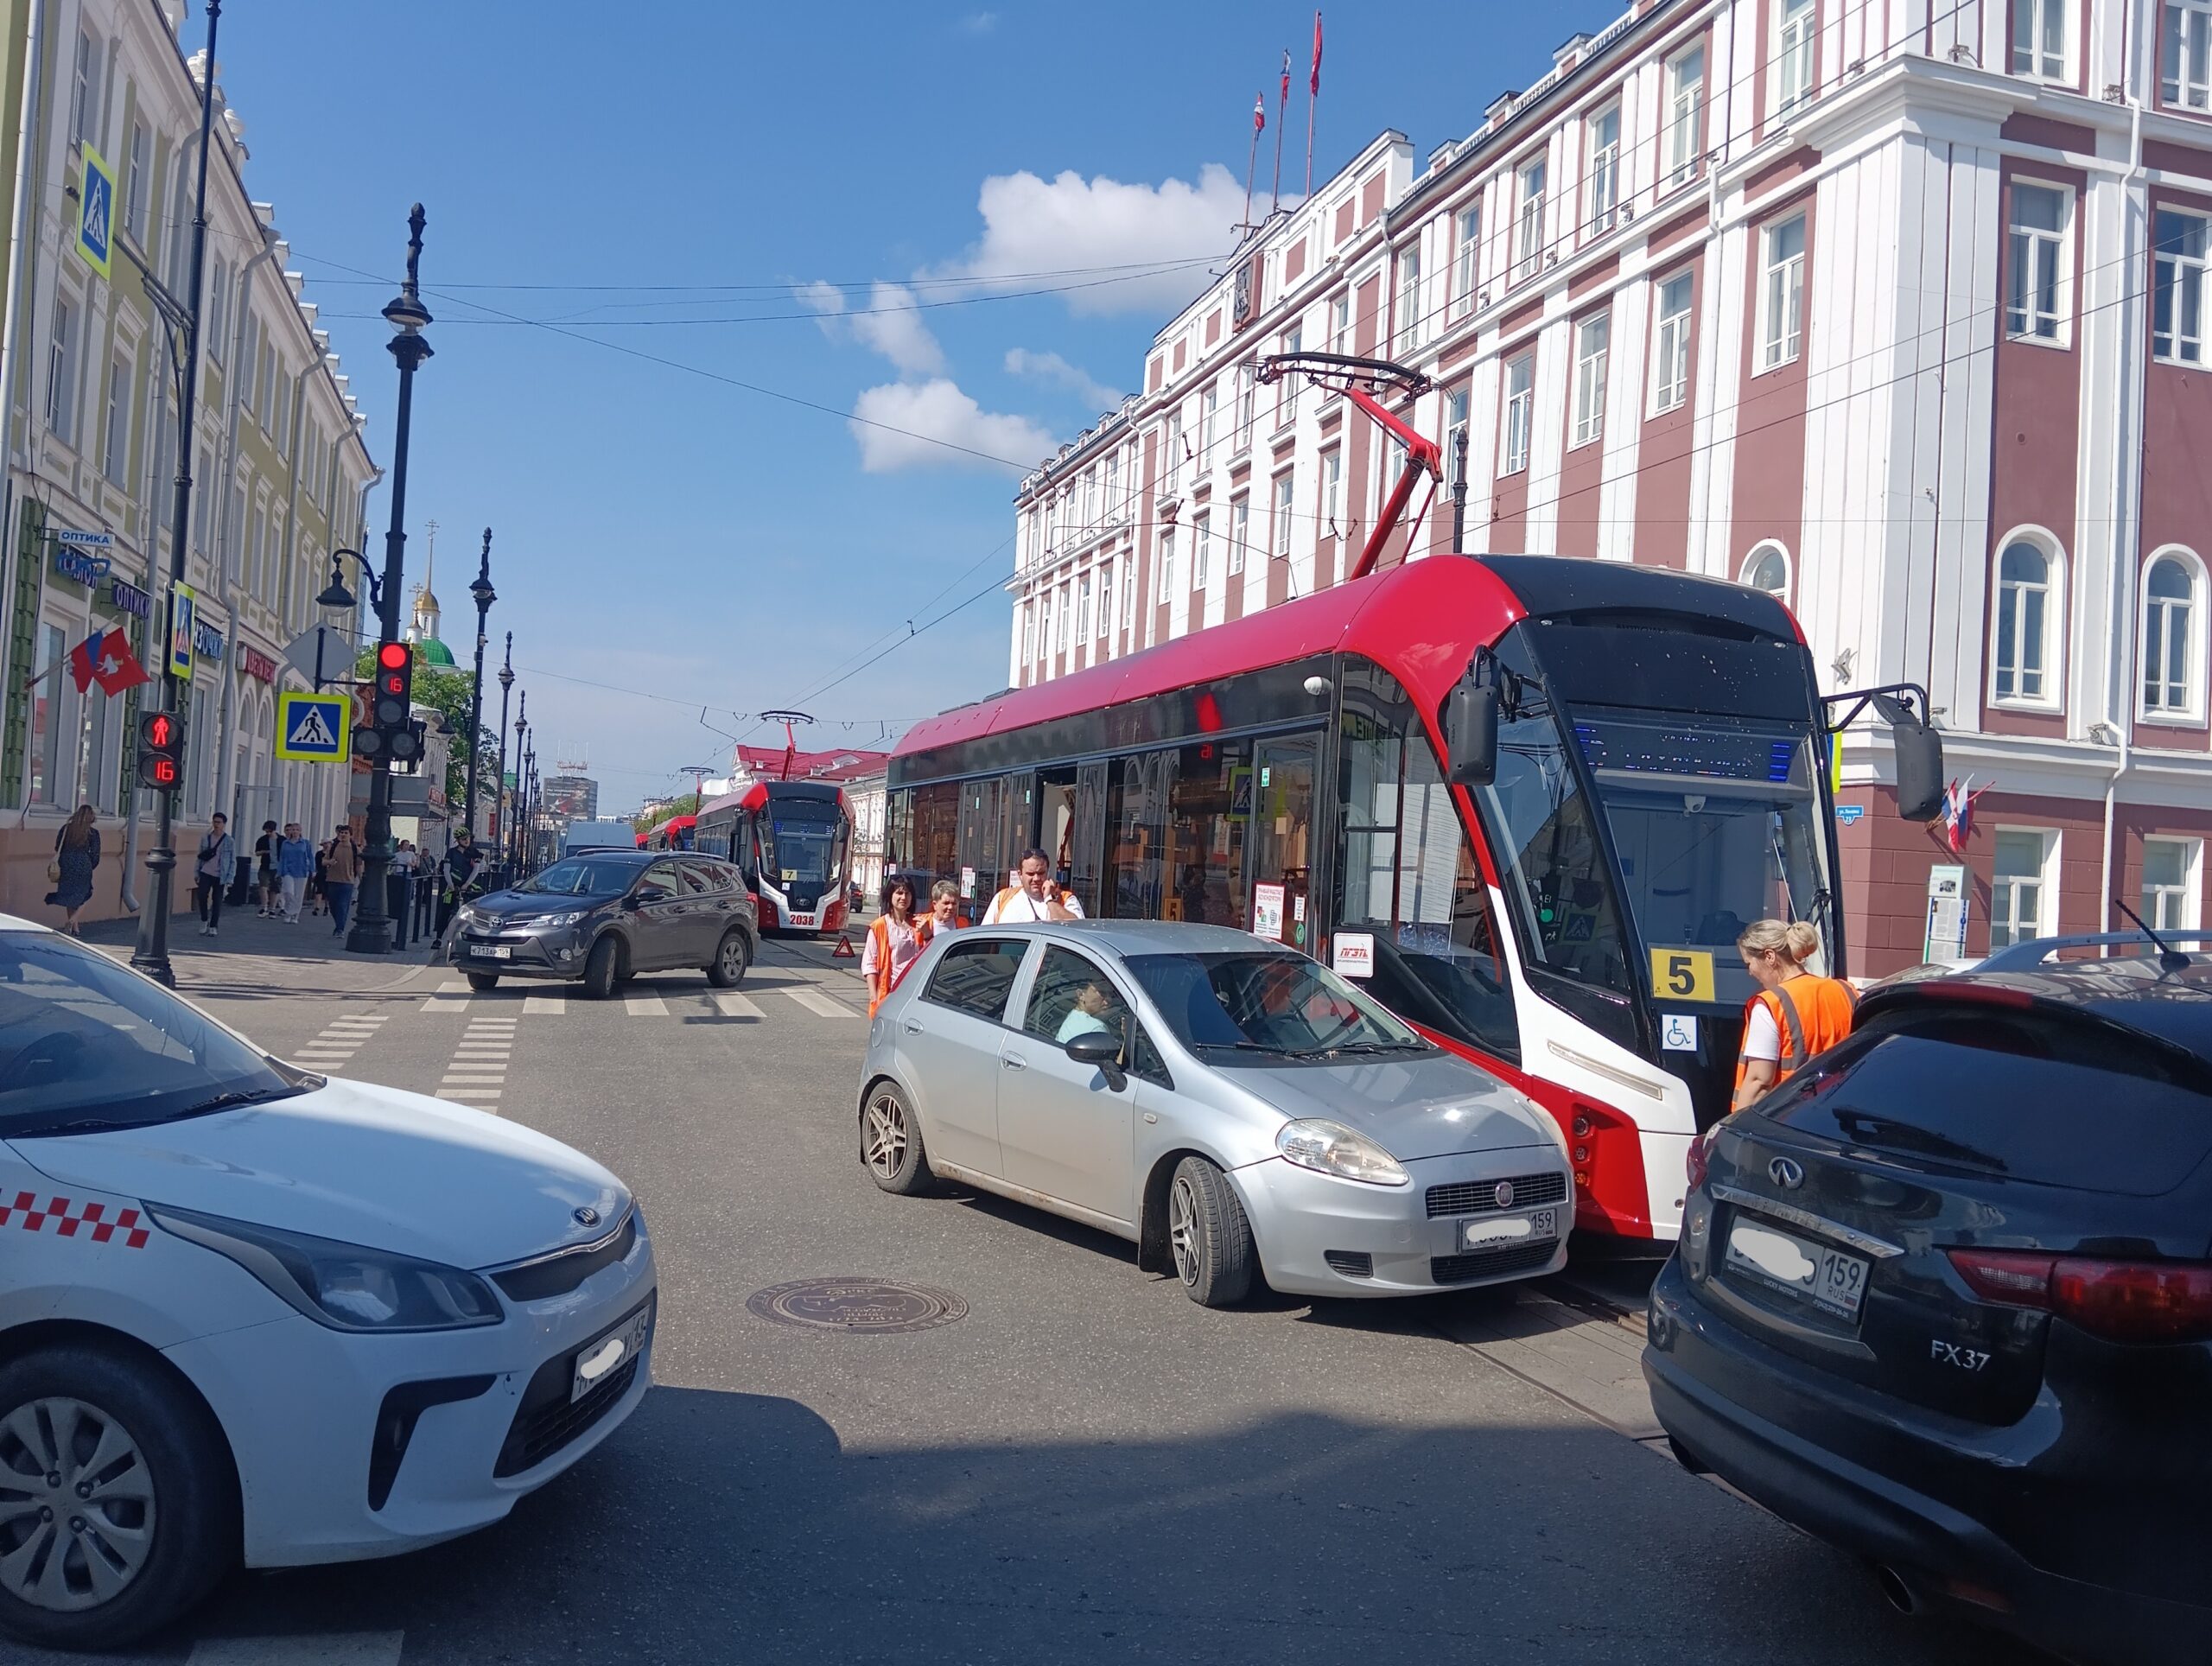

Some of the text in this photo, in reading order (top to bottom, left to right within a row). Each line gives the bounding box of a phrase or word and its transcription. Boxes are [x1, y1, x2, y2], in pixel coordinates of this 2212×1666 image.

[61, 531, 110, 544] ОПТИКА
[116, 583, 149, 620] ОПТИКИ
[194, 622, 223, 661] НЗОЧКИ
[390, 677, 402, 691] 16
[156, 762, 174, 780] 16
[786, 870, 794, 879] 7
[790, 914, 815, 926] 2038
[1669, 956, 1695, 995] 5
[1531, 1211, 1552, 1230] 159
[1824, 1255, 1860, 1291] 159
[1826, 1286, 1845, 1301] RUS
[1930, 1339, 1992, 1372] FX37
